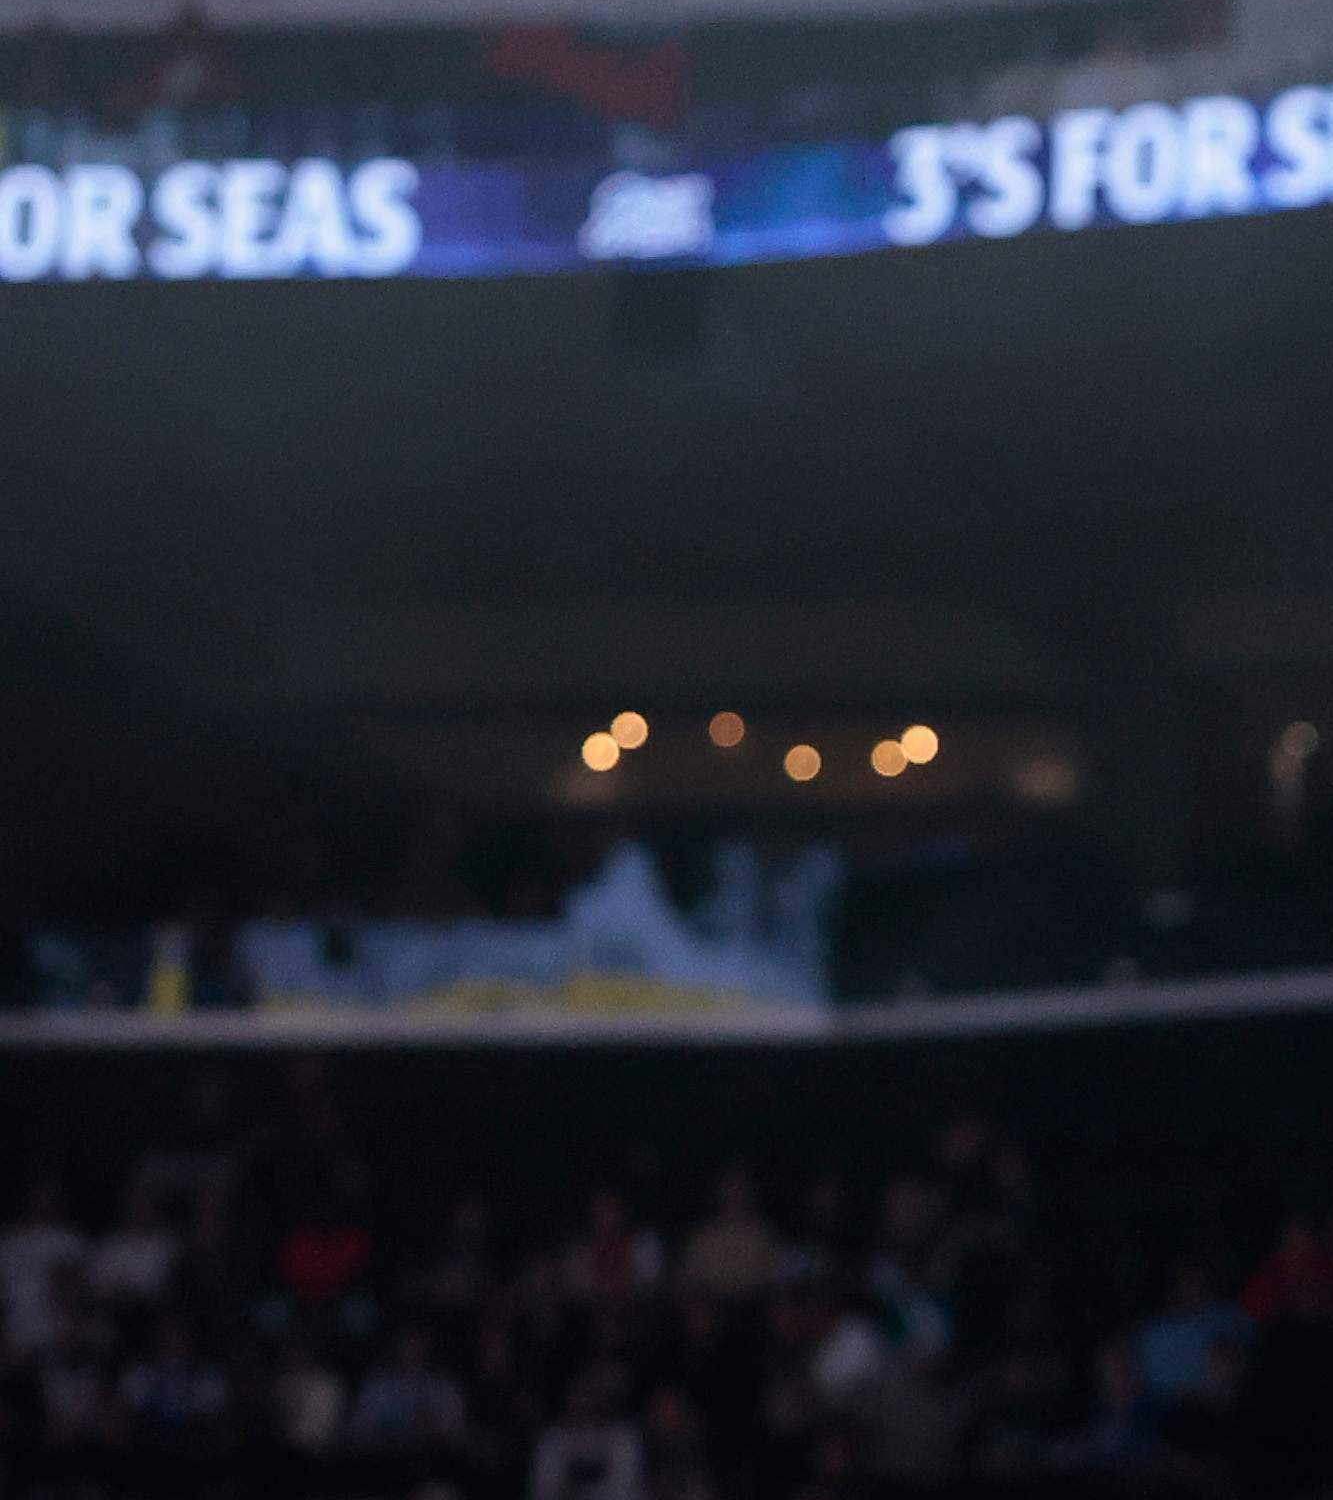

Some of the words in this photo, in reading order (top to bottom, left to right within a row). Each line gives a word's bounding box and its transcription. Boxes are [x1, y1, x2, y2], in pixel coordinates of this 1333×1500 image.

[0, 162, 144, 282] OR
[147, 157, 422, 280] SEAS
[1050, 97, 1259, 231] FOR
